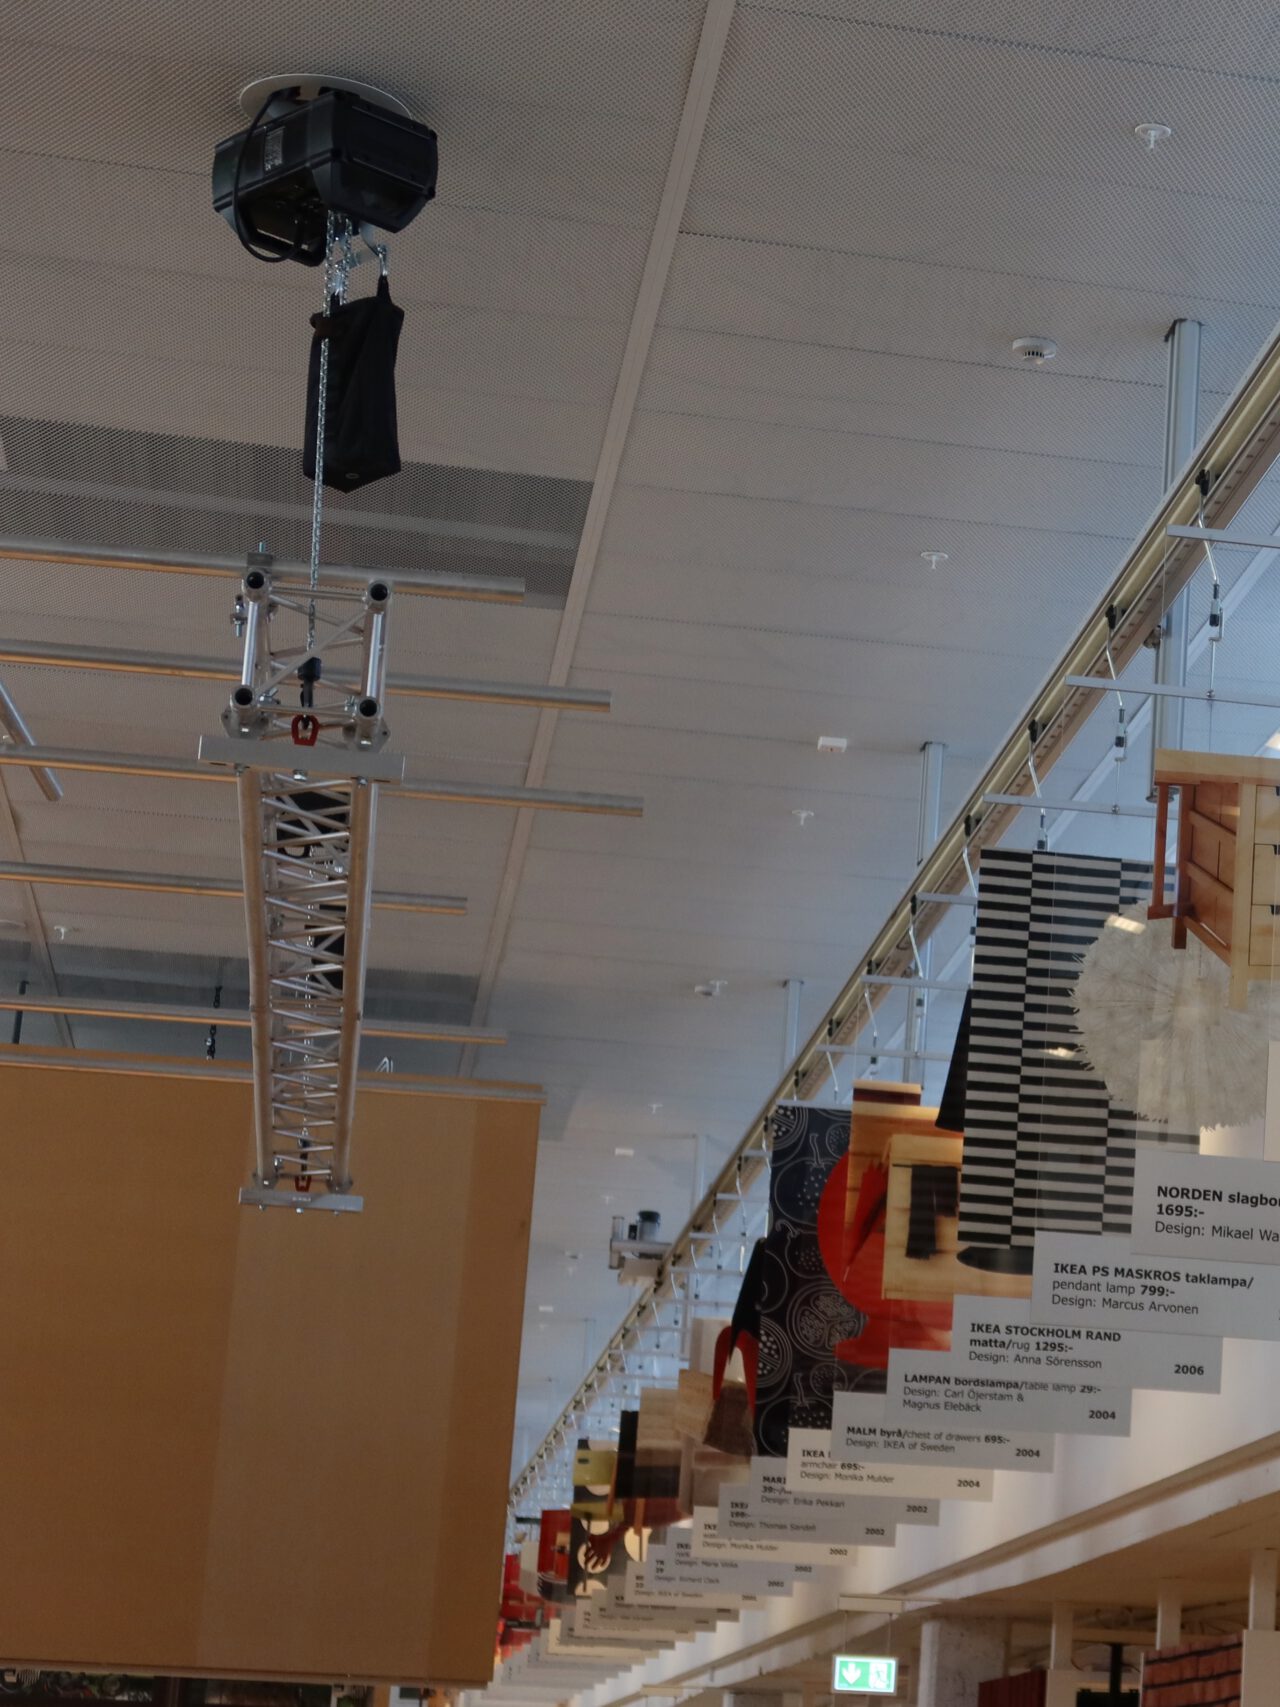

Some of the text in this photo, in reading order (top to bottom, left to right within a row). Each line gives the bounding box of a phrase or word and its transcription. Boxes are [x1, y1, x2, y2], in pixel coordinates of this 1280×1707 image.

[1157, 1186, 1222, 1202] NORDEN
[1157, 1205, 1204, 1217] 1695:-
[1155, 1221, 1205, 1237] Design:
[1212, 1225, 1253, 1240] Mikael
[1054, 1263, 1254, 1289] IKEA PS MASKROS taklampa/
[1052, 1279, 1175, 1297] pendant lamp 799:-
[1052, 1294, 1198, 1315] Design: Marcus Arvonen
[971, 1323, 1121, 1342] IKEA STOCKHOLM RAND
[970, 1337, 1073, 1352] matta/rug 1295:-
[969, 1351, 1102, 1369] Design: Anna Sörensson
[1174, 1364, 1204, 1375] 2006
[905, 1374, 950, 1385] LAMPAN
[955, 1376, 1048, 1392] bordslampa/table
[1080, 1384, 1101, 1393] 29:-
[904, 1387, 940, 1398] Design:
[944, 1389, 964, 1399] Carl
[1017, 1393, 1024, 1402] &
[903, 1399, 940, 1411] Magnus
[1089, 1409, 1115, 1420] 2004
[847, 1427, 876, 1437] MALM
[934, 1431, 943, 1440] of
[846, 1438, 879, 1449] Design:
[884, 1440, 905, 1449] IKEA
[908, 1441, 918, 1450] of
[803, 1450, 824, 1458] IKEA
[1015, 1448, 1040, 1457] 2004
